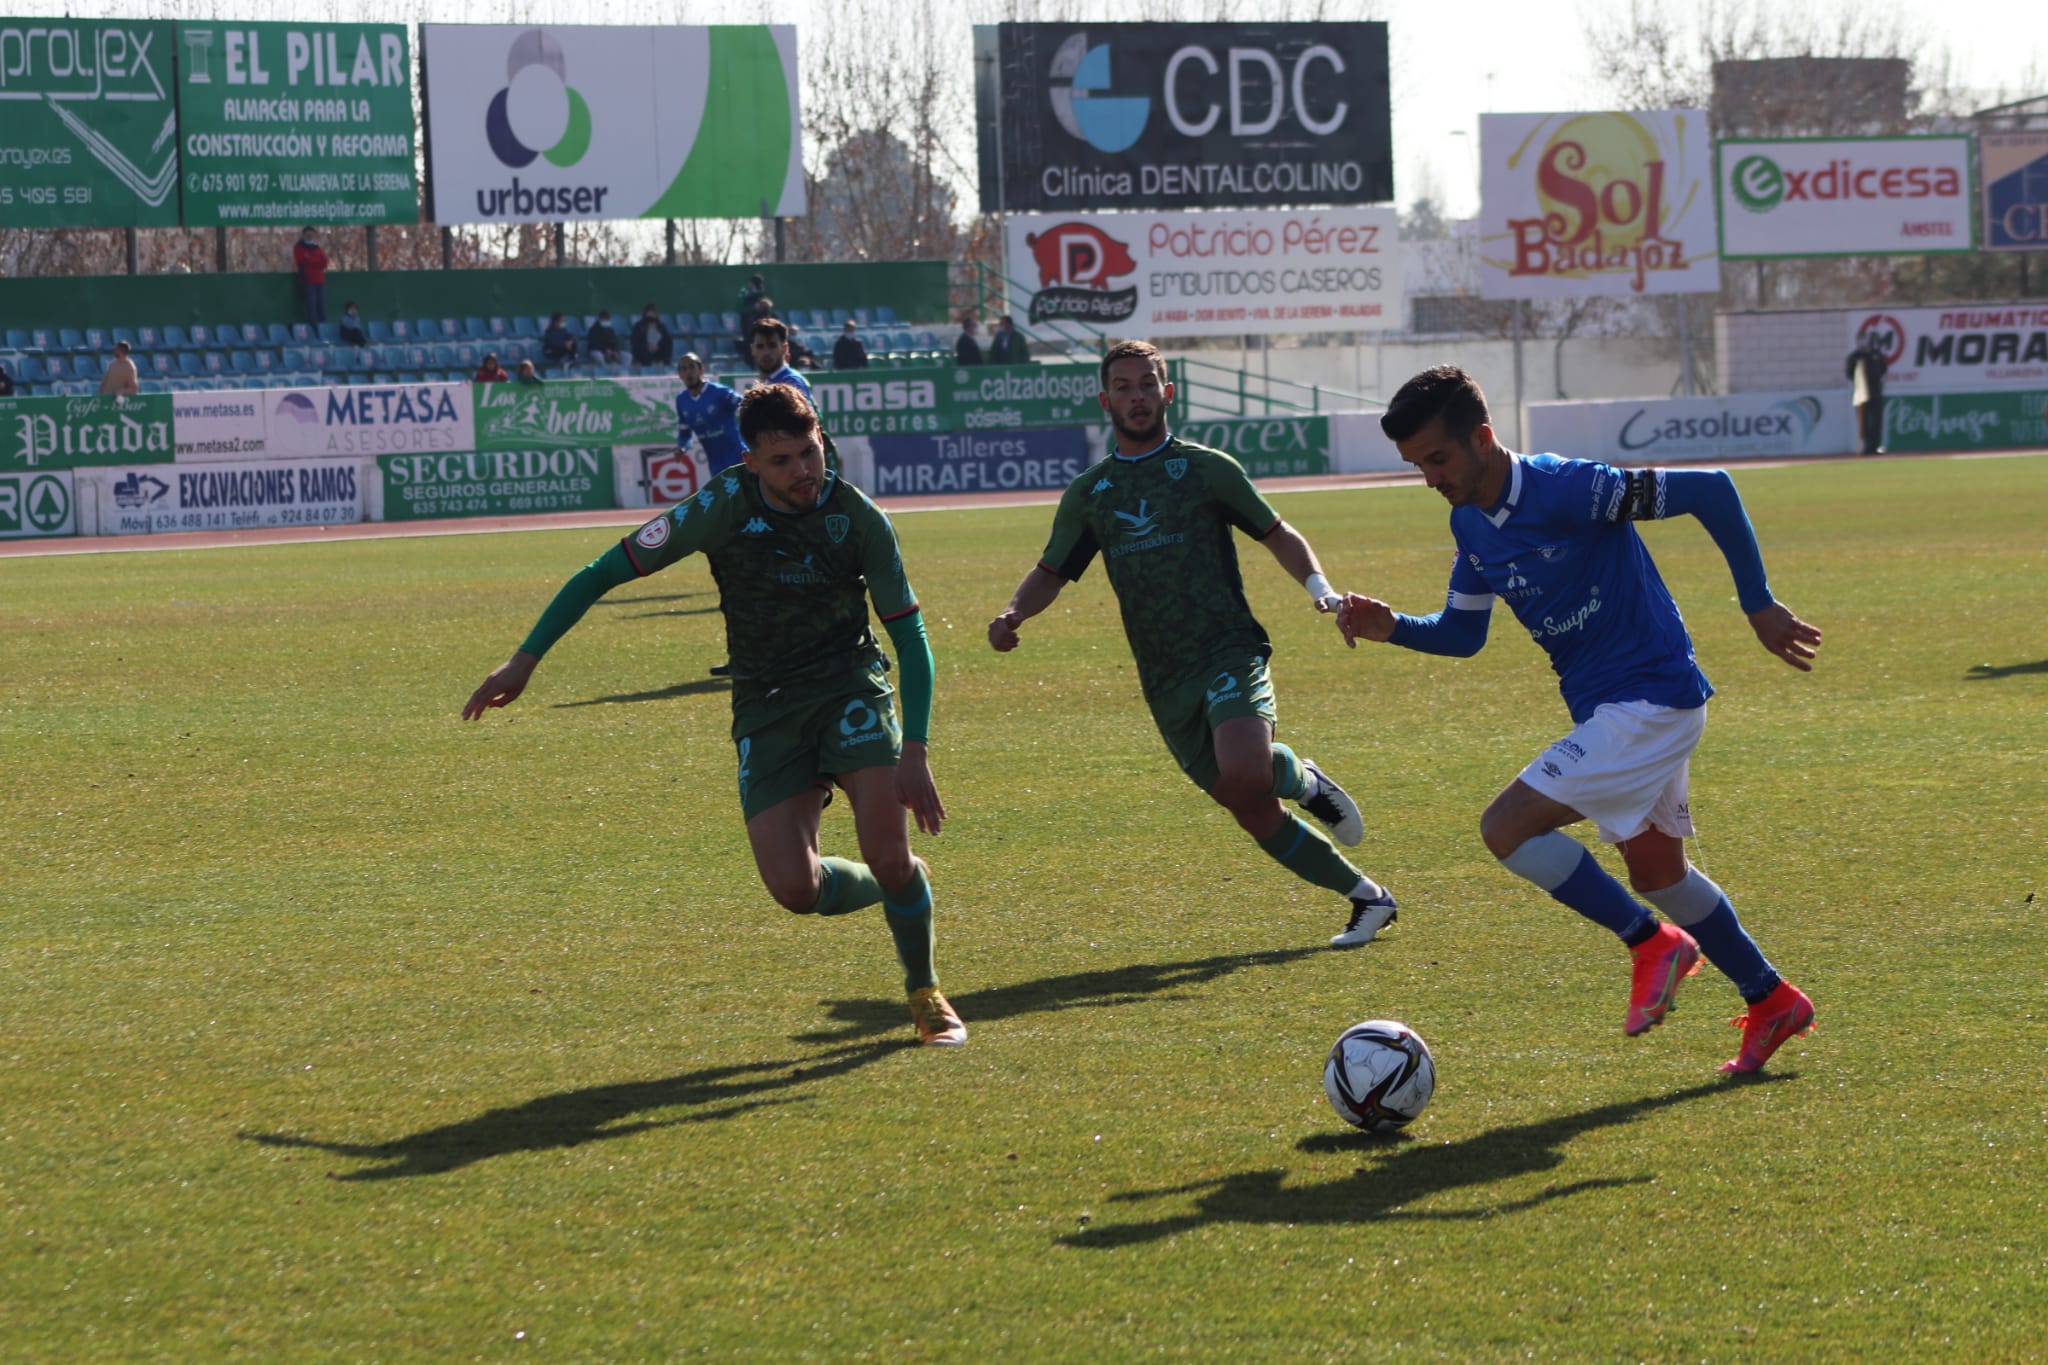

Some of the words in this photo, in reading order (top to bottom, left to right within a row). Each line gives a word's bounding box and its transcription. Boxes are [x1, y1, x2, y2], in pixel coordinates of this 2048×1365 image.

[225, 30, 269, 85] EL
[286, 31, 404, 87] PILAR
[224, 91, 299, 121] ALMACÉN
[303, 99, 347, 122] PARA
[351, 99, 371, 122] LA
[1164, 45, 1348, 137] CDC
[187, 128, 312, 157] CONSTRUCCIÓN
[316, 134, 327, 157] Y
[331, 134, 408, 157] REFORMA
[202, 173, 223, 192] 675
[225, 173, 246, 192] 901
[248, 173, 269, 192] 927
[279, 173, 339, 192] VILLANUEVA
[341, 173, 355, 192] DE
[358, 173, 371, 192] LA
[373, 173, 411, 192] SERENA
[1042, 166, 1132, 196] Clínica
[1141, 163, 1363, 194] DENTALCOLINO
[1537, 141, 1664, 245] Sol
[218, 201, 385, 221] www.materialeselpilar.com
[477, 177, 608, 217] urbaser
[1149, 220, 1274, 258] Patricio
[1283, 217, 1381, 256] Pérez
[1507, 217, 1689, 292] Badajoz
[1150, 270, 1275, 297] EMBUTIDOS
[1280, 267, 1382, 294] CASEROS
[326, 387, 458, 426] METASA
[14, 414, 169, 465] Picada
[327, 427, 455, 451] ASESORES
[931, 436, 1026, 459] Talleres
[389, 448, 600, 486] SEGURDON
[878, 459, 1079, 493] MIRAFLORES
[179, 469, 295, 508] EXCAVACIONES
[300, 466, 356, 503] RAMOS
[402, 483, 486, 501] SEGUROS
[489, 477, 591, 496] GENERALES
[466, 499, 488, 511] 474
[561, 494, 582, 506] 174
[156, 514, 178, 529] 636
[207, 511, 226, 527] 141
[281, 508, 302, 523] 924
[306, 508, 320, 522] 84
